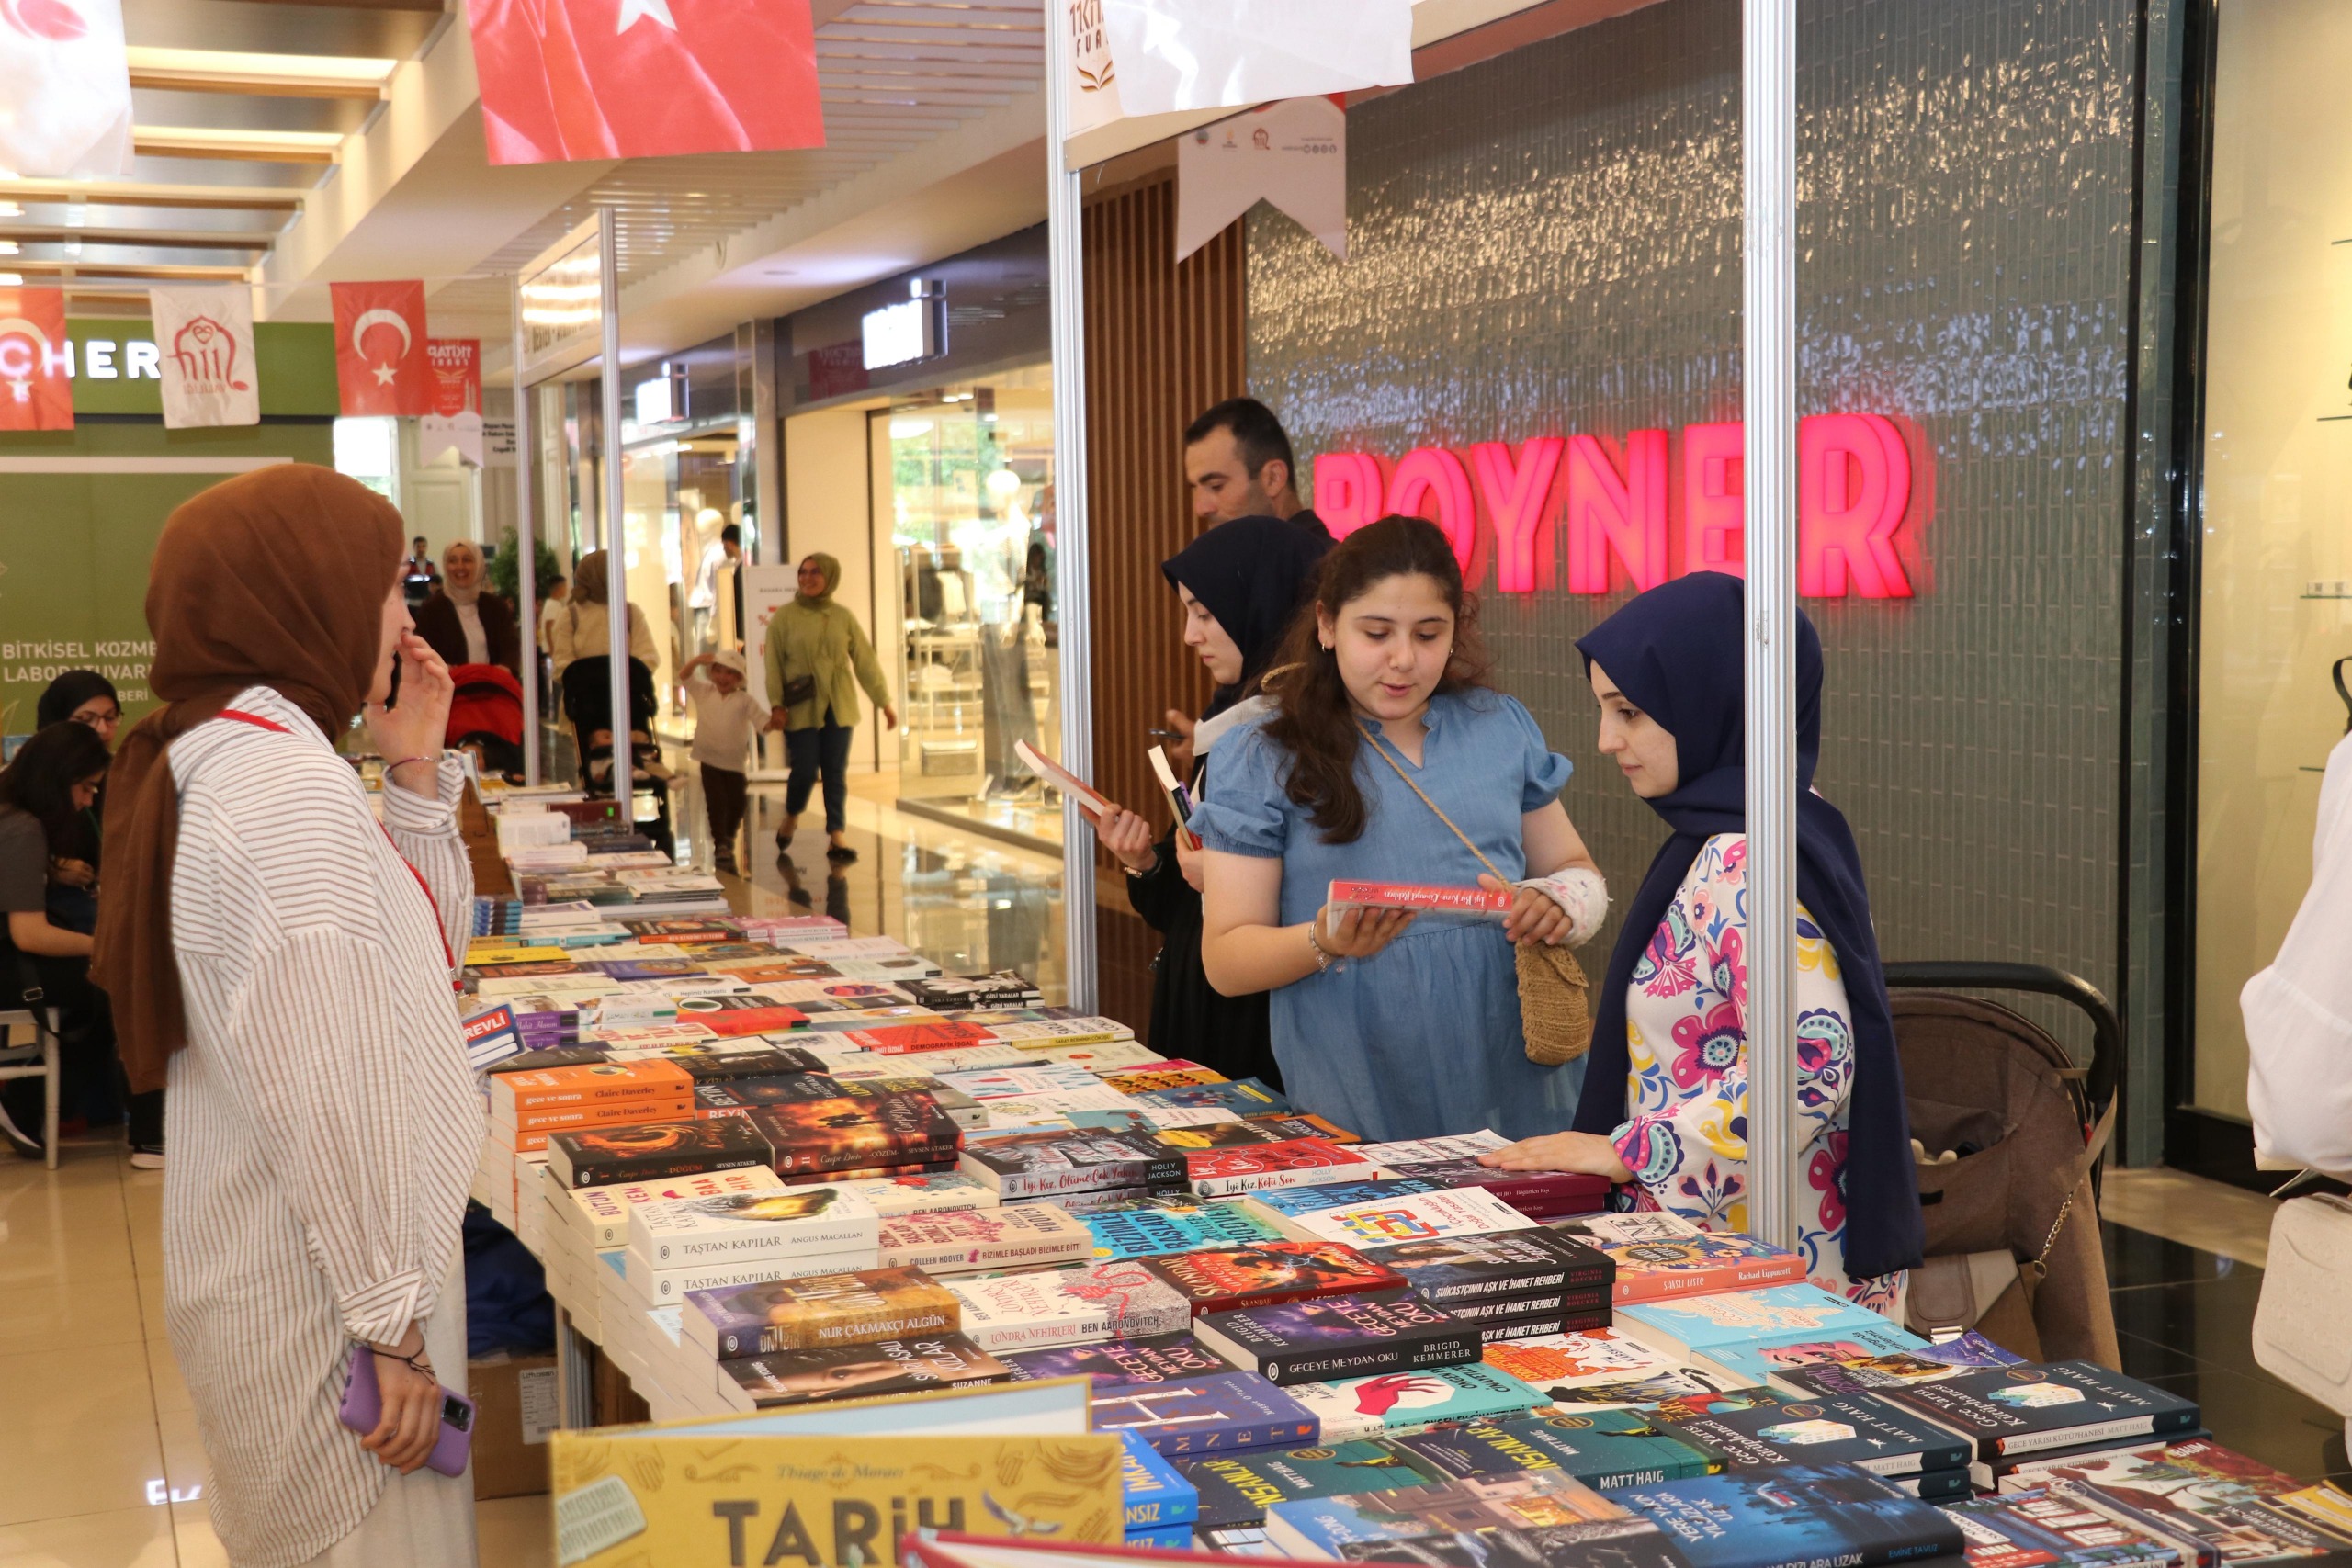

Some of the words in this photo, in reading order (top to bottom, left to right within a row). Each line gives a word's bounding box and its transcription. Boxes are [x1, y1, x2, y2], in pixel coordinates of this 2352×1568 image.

[1077, 28, 1109, 58] FUA
[1313, 412, 1915, 599] BOYNER
[2, 640, 91, 660] BİTKİSEL
[117, 688, 149, 702] BERİ
[985, 992, 998, 1000] GİZLİ
[999, 991, 1020, 999] YARALAR
[910, 1040, 953, 1051] DEMOGRAFİK
[954, 1038, 974, 1049] İŞGAL
[526, 1094, 546, 1105] gece
[557, 1093, 582, 1102] sonra
[595, 1088, 620, 1098] Claire
[622, 1085, 655, 1097] Daverley
[528, 1114, 548, 1125] gece
[560, 1112, 583, 1122] sonra
[597, 1108, 622, 1118] Claire
[623, 1105, 657, 1117] Daverley
[527, 1136, 547, 1146] gece
[930, 1144, 954, 1153] ATAKER
[737, 1159, 757, 1168] ATAKER
[1151, 1162, 1176, 1170] HOLLY
[1311, 1168, 1332, 1177] HOLLY
[1023, 1175, 1038, 1192] İyi
[1148, 1169, 1182, 1180] JACKSON
[1226, 1178, 1239, 1193] İyi
[1257, 1175, 1278, 1189] Kötü
[1279, 1175, 1296, 1186] Son
[1308, 1175, 1337, 1184] JACKSON
[583, 1190, 623, 1216] BÜTÜN
[1013, 1207, 1065, 1234] HOOVER
[1125, 1210, 1195, 1250] BAŞLADI
[683, 1241, 729, 1256] TAŞTAN
[732, 1236, 782, 1250] KAPILAR
[791, 1235, 819, 1244] ANGUS
[820, 1231, 864, 1241] MACALLAN
[910, 1255, 937, 1267] COLLEEN
[938, 1253, 965, 1264] HOOVER
[982, 1247, 1009, 1259] BİZİMLE
[1010, 1246, 1038, 1259] BAŞLADI
[1039, 1244, 1064, 1256] BİZİMLE
[1066, 1242, 1082, 1253] BİTTİ
[684, 1276, 729, 1290] TAŞTAN
[732, 1270, 782, 1284] KAPILAR
[791, 1269, 819, 1278] ANGUS
[820, 1265, 863, 1275] MACALLAN
[1570, 1269, 1603, 1278] VIRGINIA
[1570, 1275, 1603, 1284] BOECKER
[1737, 1268, 1760, 1280] Rachael
[1761, 1266, 1792, 1280] Lippincott
[1435, 1280, 1482, 1299] SUİKASTÇININ
[1483, 1281, 1498, 1295] AŞK
[1498, 1280, 1509, 1292] VE
[1509, 1277, 1533, 1291] İHANET
[1533, 1272, 1565, 1287] REHBERİ
[1240, 1298, 1272, 1308] SKANDAR
[1566, 1292, 1600, 1301] VIRGINIA
[1449, 1306, 1480, 1320] ASTÇININ
[1479, 1304, 1494, 1318] AŞK
[1494, 1303, 1506, 1314] VE
[1506, 1301, 1531, 1314] İHANET
[1531, 1295, 1561, 1311] REHBERİ
[819, 1325, 842, 1338] NUR
[843, 1320, 904, 1338] ÇAKMAKÇI
[906, 1314, 945, 1329] ALGÜN
[990, 1328, 1028, 1344] LONDRA
[1028, 1323, 1078, 1339] NEHİRLERİ
[1081, 1321, 1100, 1334] BEN
[1101, 1315, 1160, 1332] AARONOVITCH
[1226, 1319, 1261, 1344] BRIGID
[1231, 1313, 1290, 1348] KEMMERER
[1481, 1329, 1494, 1344] AŞK
[1494, 1328, 1506, 1340] VE
[1506, 1325, 1531, 1338] İHANET
[1531, 1320, 1561, 1335] REHBERİ
[914, 1339, 972, 1371] KIZLAR
[1412, 1348, 1472, 1364] KEMMERER
[1423, 1340, 1461, 1353] BRIGID
[1289, 1359, 1330, 1374] GECEYE
[1331, 1353, 1375, 1372] MEYDAN
[1377, 1351, 1399, 1363] OKU
[952, 1378, 993, 1391] SUZANNE
[2052, 1366, 2102, 1386] HAIG
[1912, 1388, 1958, 1410] Yarısı
[1929, 1383, 2028, 1427] Kütüphanesi
[2096, 1385, 2152, 1407] MATT
[1831, 1401, 1877, 1422] HAIG
[1957, 1407, 1998, 1427] Gece
[1681, 1424, 1723, 1448] Yarısı
[1701, 1418, 1791, 1464] Kütüphanesi
[1871, 1421, 1924, 1445] MATT
[2007, 1439, 2027, 1450] GECE
[2028, 1437, 2052, 1447] YARISI
[2052, 1427, 2105, 1444] KÜTÜPHANESİ
[2107, 1424, 2129, 1435] MATT
[2130, 1421, 2148, 1432] HAIG
[1722, 1443, 1759, 1464] Gece
[775, 1463, 828, 1483] Thiago
[831, 1464, 846, 1479] de
[852, 1463, 905, 1480] Moraes
[1873, 1461, 1895, 1472] MATT
[1896, 1459, 1916, 1470] HAIG
[1600, 1472, 1634, 1490] MATT
[1635, 1470, 1664, 1485] HAIG
[1629, 1494, 1673, 1517] YAKIN
[712, 1495, 966, 1568] TARİH
[1664, 1517, 1705, 1543] YERE
[1832, 1552, 1864, 1567] UZAK
[1888, 1546, 1913, 1559] EMİNE
[1914, 1543, 1939, 1555] TAVUZ
